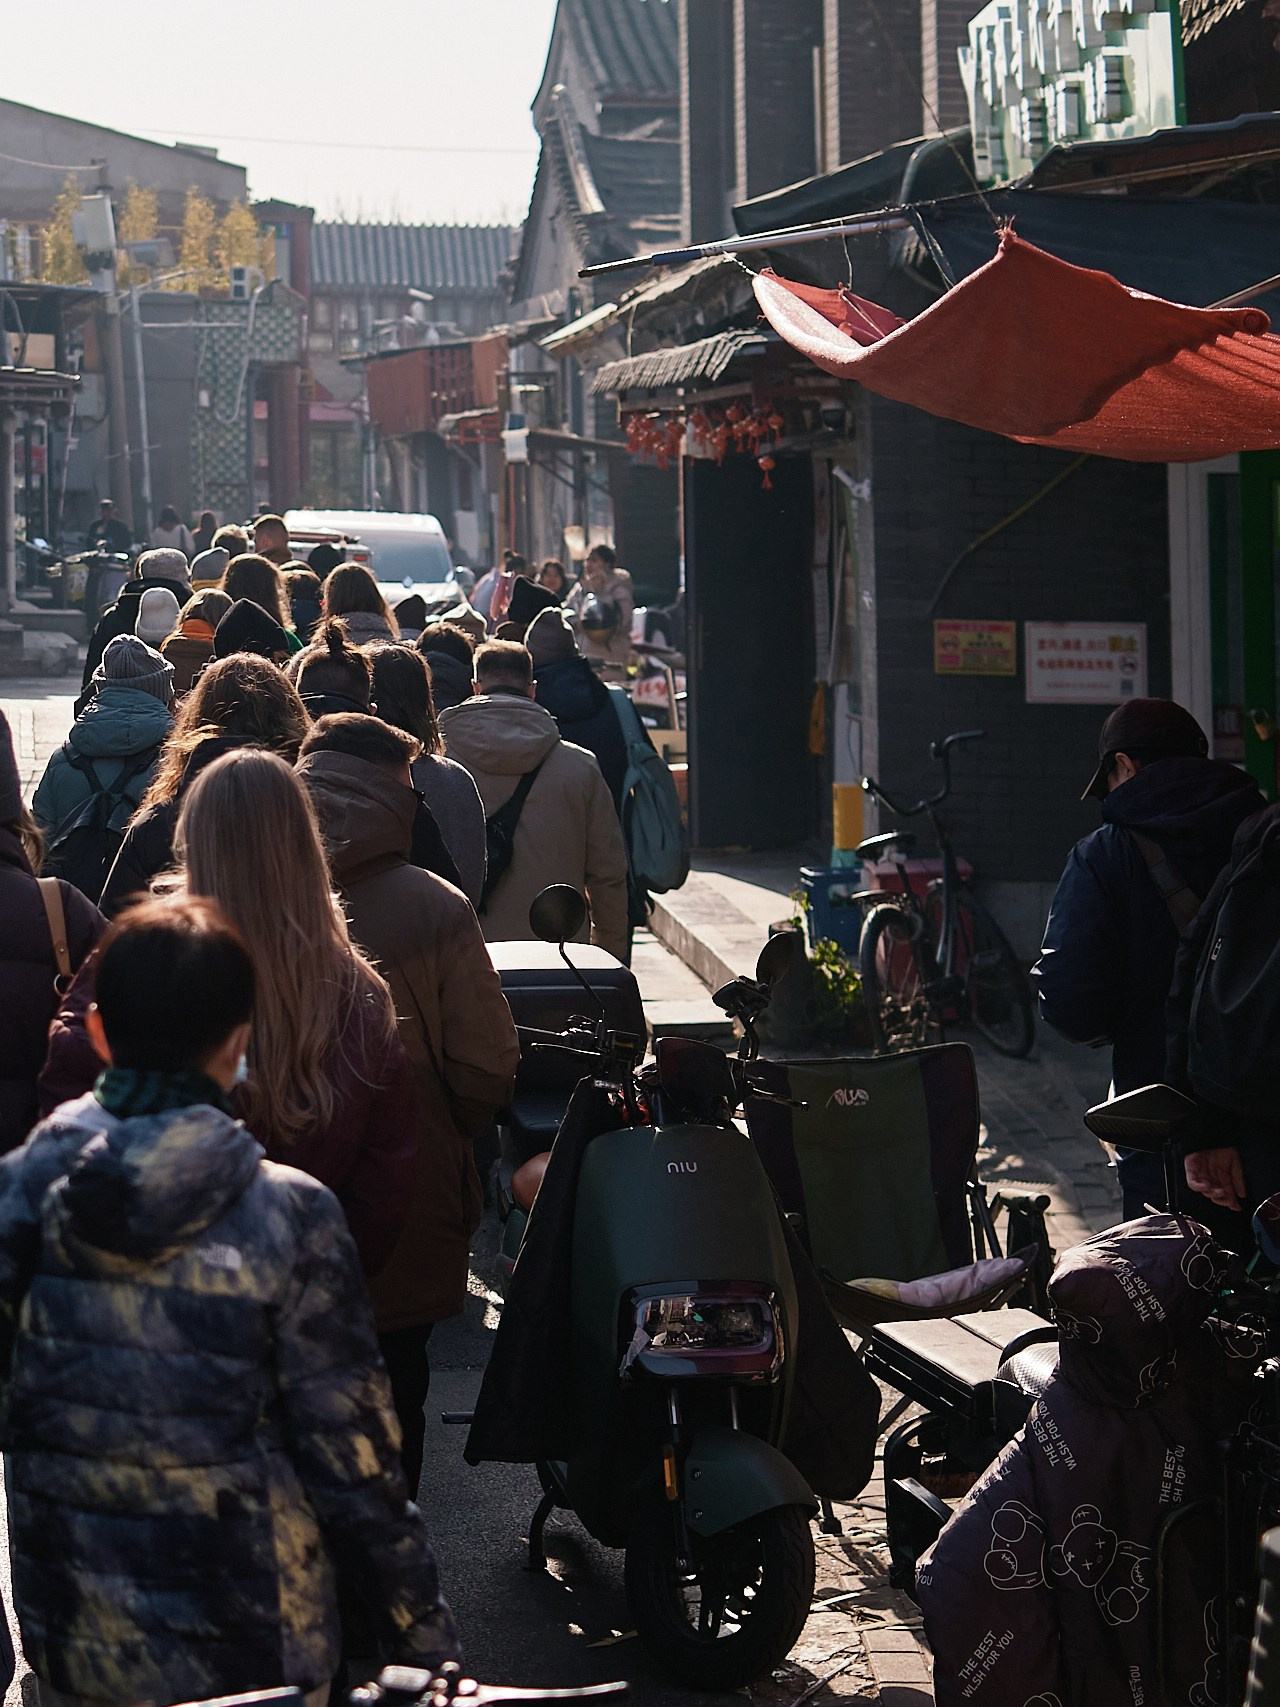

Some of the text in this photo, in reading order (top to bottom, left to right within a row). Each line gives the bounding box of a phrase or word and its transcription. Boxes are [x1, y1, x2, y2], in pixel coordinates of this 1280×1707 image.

[1114, 1272, 1150, 1322] THE BEST
[1133, 1276, 1150, 1295] FOR
[1045, 1418, 1062, 1440] FOR
[1043, 1442, 1060, 1466] THE
[1056, 1440, 1077, 1470] WLSH
[1159, 1448, 1176, 1503] THE BEST
[958, 1630, 997, 1680] THE BEST
[962, 1629, 1014, 1698] WLSH FOR YOU
